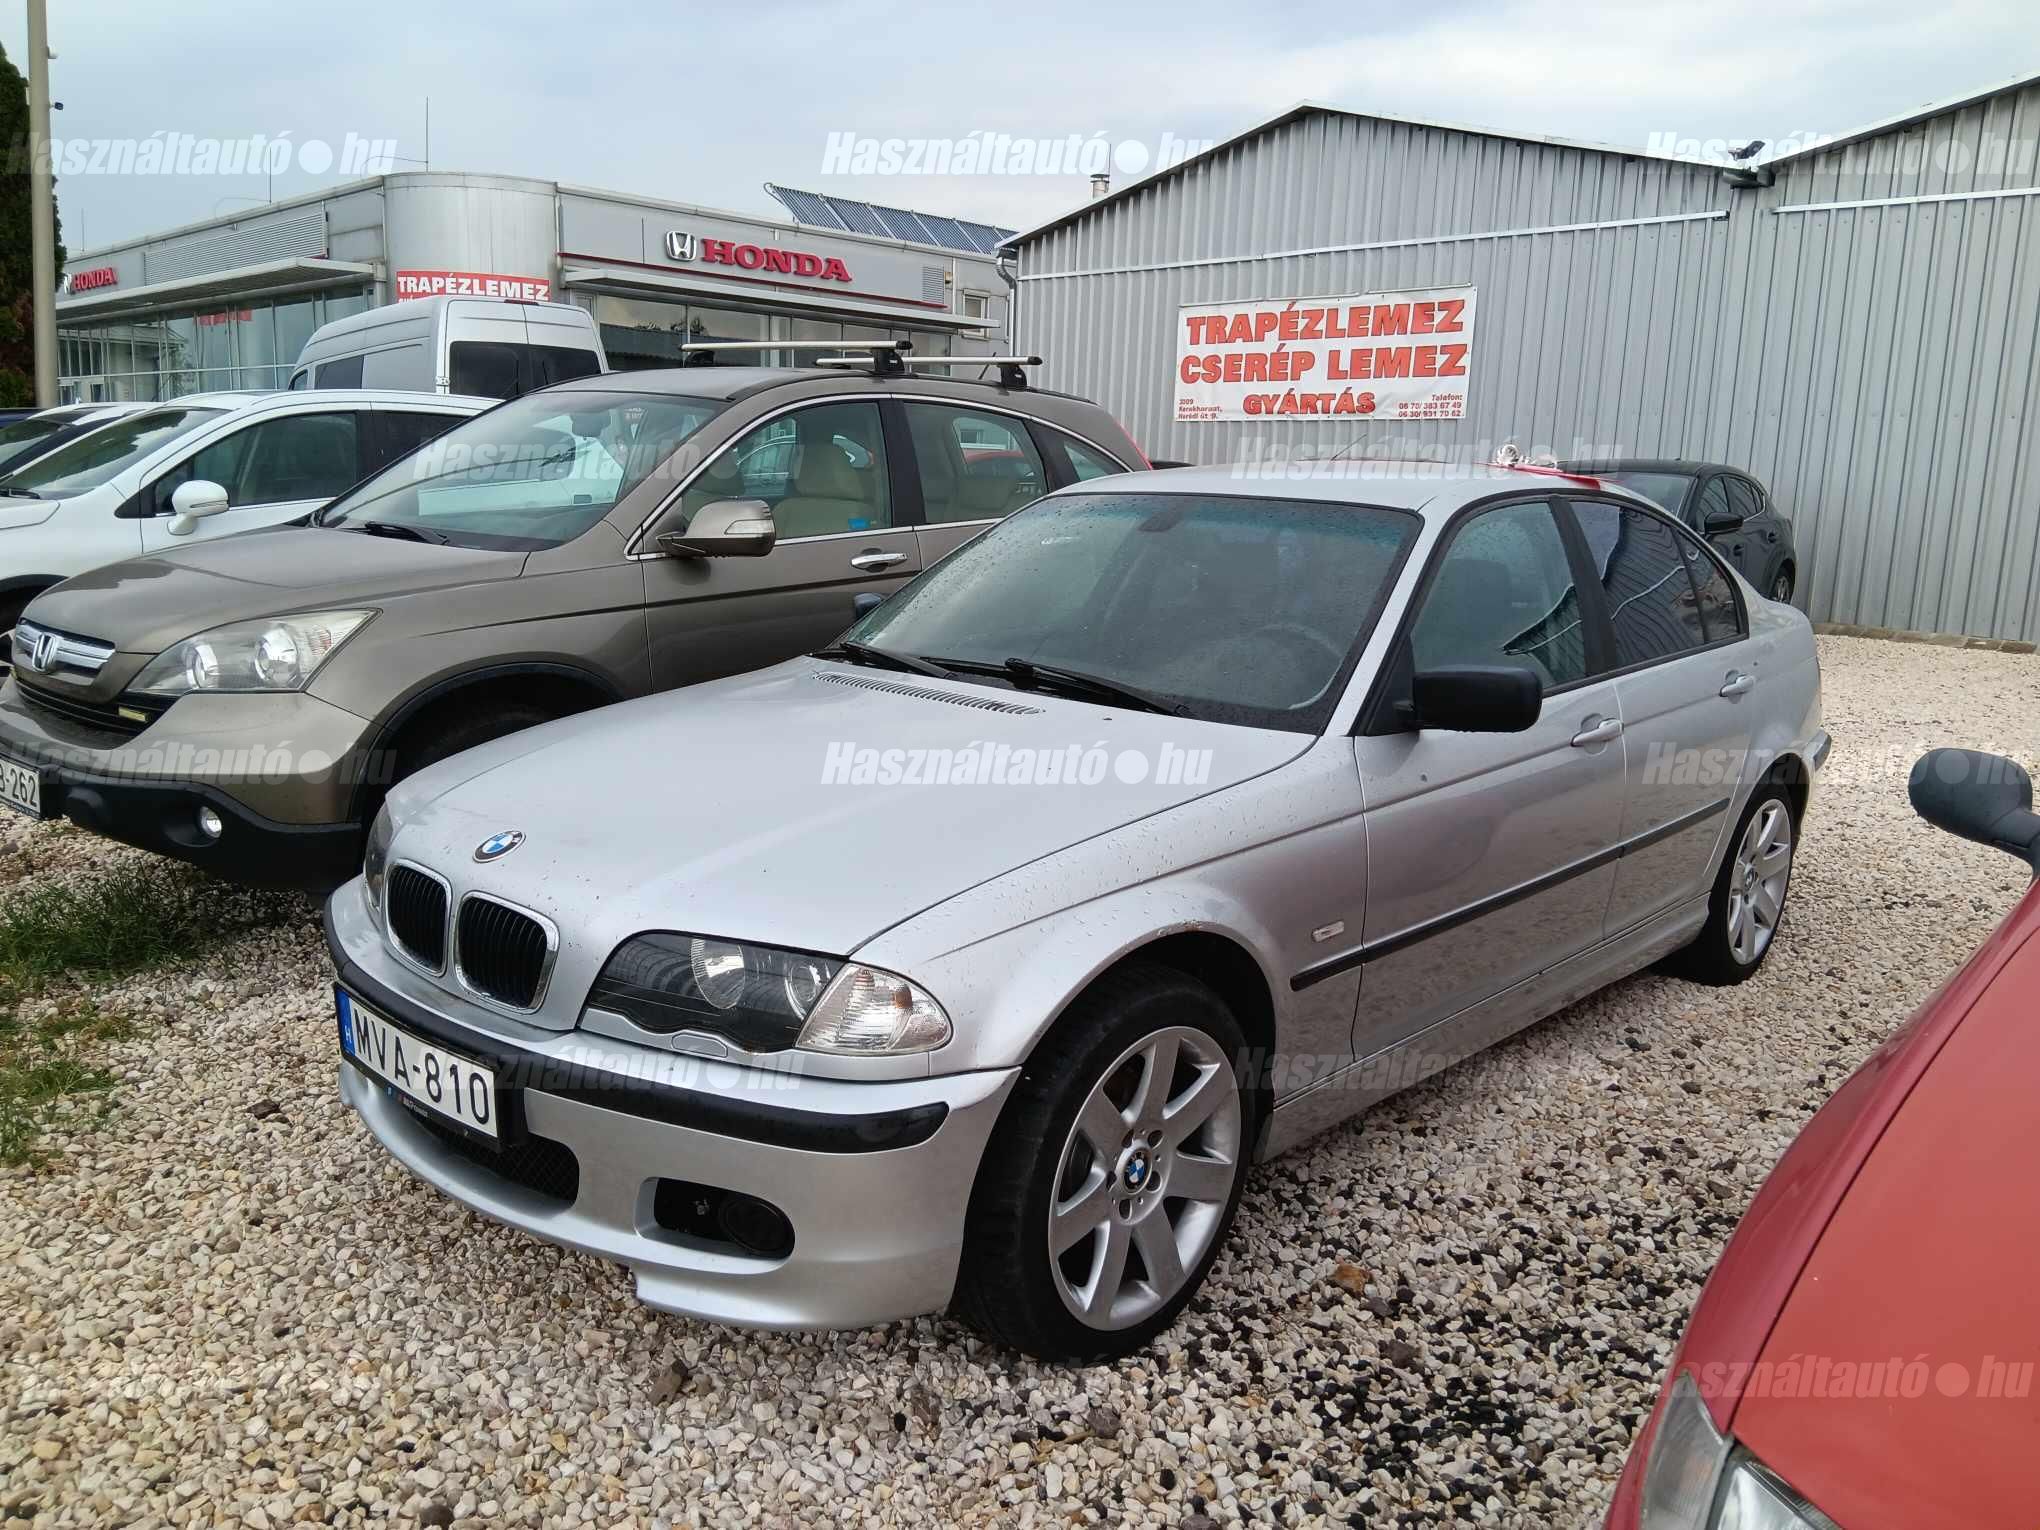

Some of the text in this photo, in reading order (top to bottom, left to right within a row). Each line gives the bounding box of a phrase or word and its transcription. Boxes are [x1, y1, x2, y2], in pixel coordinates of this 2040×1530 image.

[72, 267, 119, 292] HONDA
[701, 238, 852, 282] HONDA
[397, 273, 549, 301] TRAPÉZLEMEZ
[1186, 300, 1466, 346] TRAPÉZLEMEZ
[1180, 343, 1468, 384] CSERÉP LEMEZ
[1242, 387, 1376, 416] GYÁRTÁS
[354, 1008, 490, 1126] MVA-810
